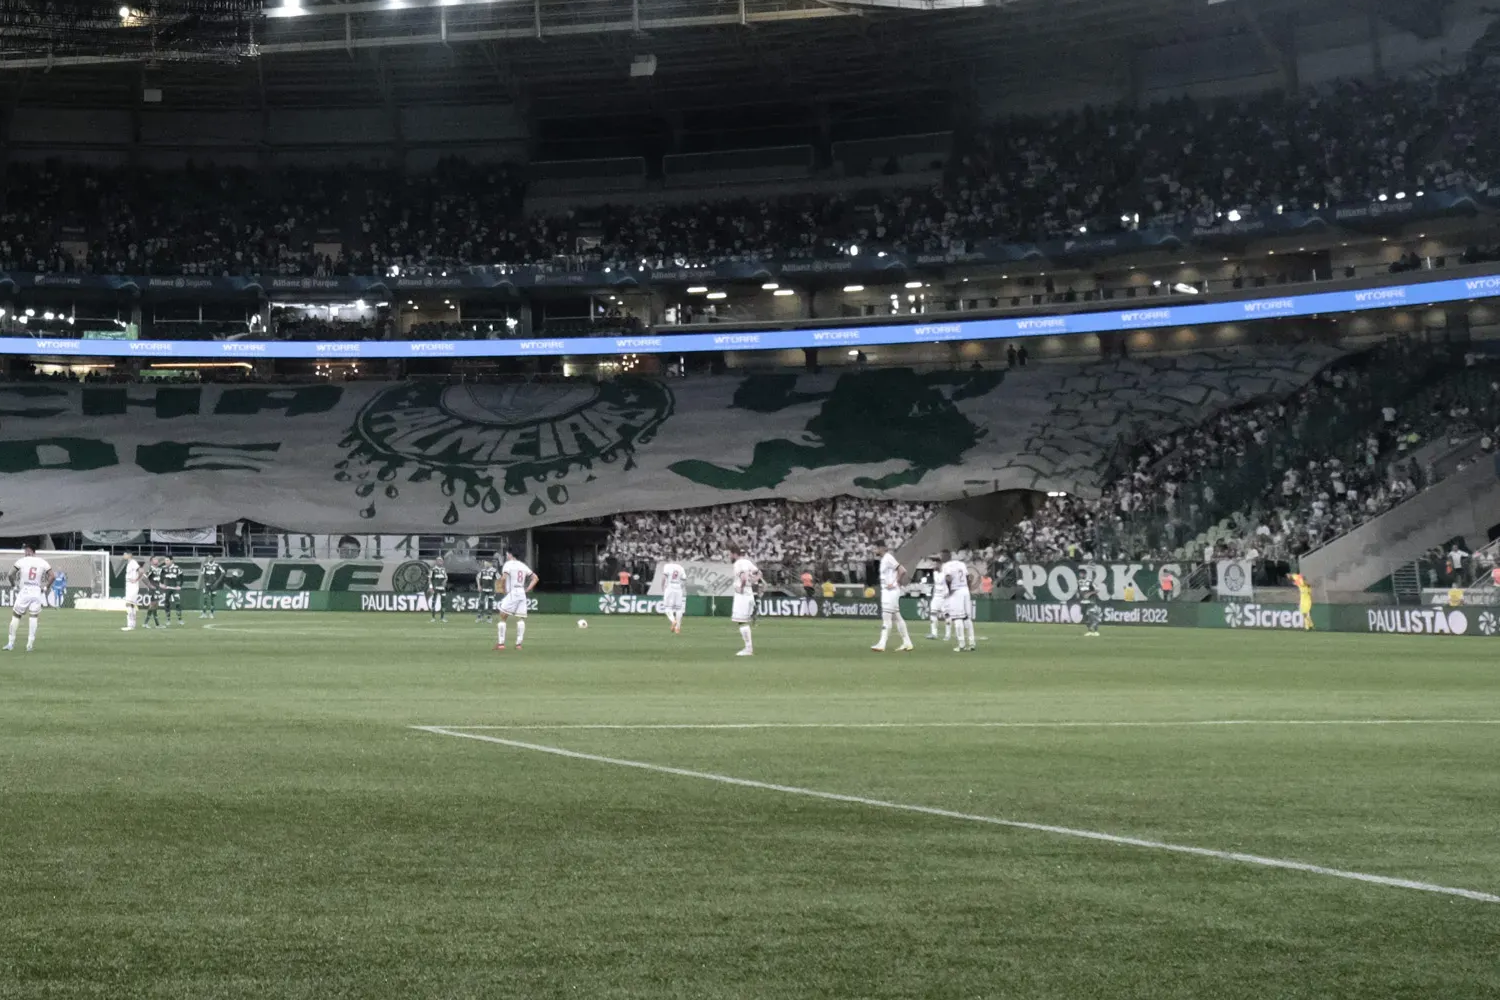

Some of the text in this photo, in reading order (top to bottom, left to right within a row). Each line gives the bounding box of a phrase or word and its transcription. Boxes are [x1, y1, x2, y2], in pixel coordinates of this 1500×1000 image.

[149, 278, 174, 287] Allianz
[273, 278, 338, 289] Allianz Parque
[1356, 290, 1404, 301] WTORRE
[1245, 300, 1292, 311] WTORRE
[1122, 311, 1169, 321] WTORRE
[1017, 319, 1064, 328] WTORRE
[814, 331, 858, 339] WTORRE
[915, 325, 960, 334] WTORRE
[28, 566, 38, 581] 6
[517, 570, 524, 583] 8
[958, 569, 965, 583] 2
[244, 590, 310, 610] Sicredi
[832, 602, 858, 616] Sicredi
[859, 603, 878, 616] 2022
[1104, 608, 1140, 623] Sicredi
[1141, 609, 1168, 623] 2022
